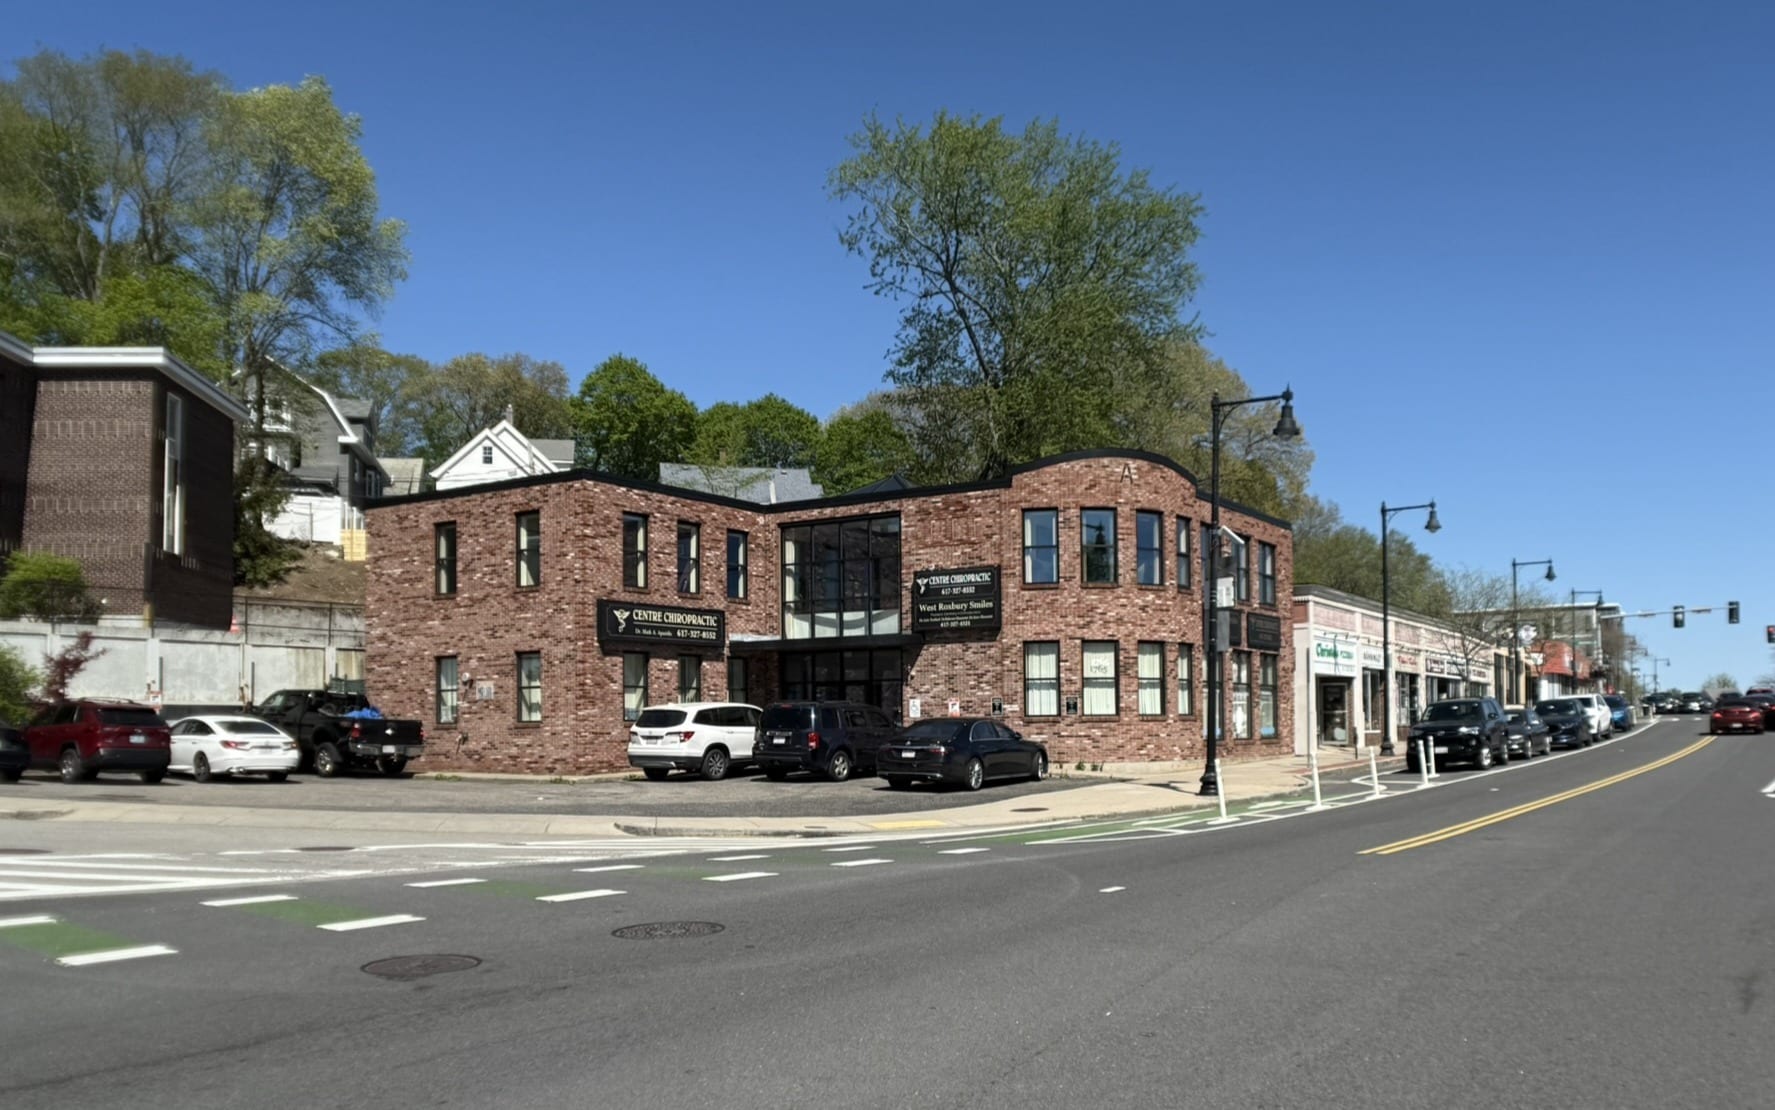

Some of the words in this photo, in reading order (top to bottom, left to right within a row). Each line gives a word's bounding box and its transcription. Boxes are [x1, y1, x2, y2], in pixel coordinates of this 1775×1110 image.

[929, 575, 949, 584] CENTRE
[951, 572, 991, 583] CHIROPRACTIC
[919, 603, 937, 612] West
[938, 601, 968, 611] Roxbury
[969, 600, 993, 609] Smiles
[633, 609, 662, 622] CENTRE
[664, 612, 717, 626] CHIROPRACTIC
